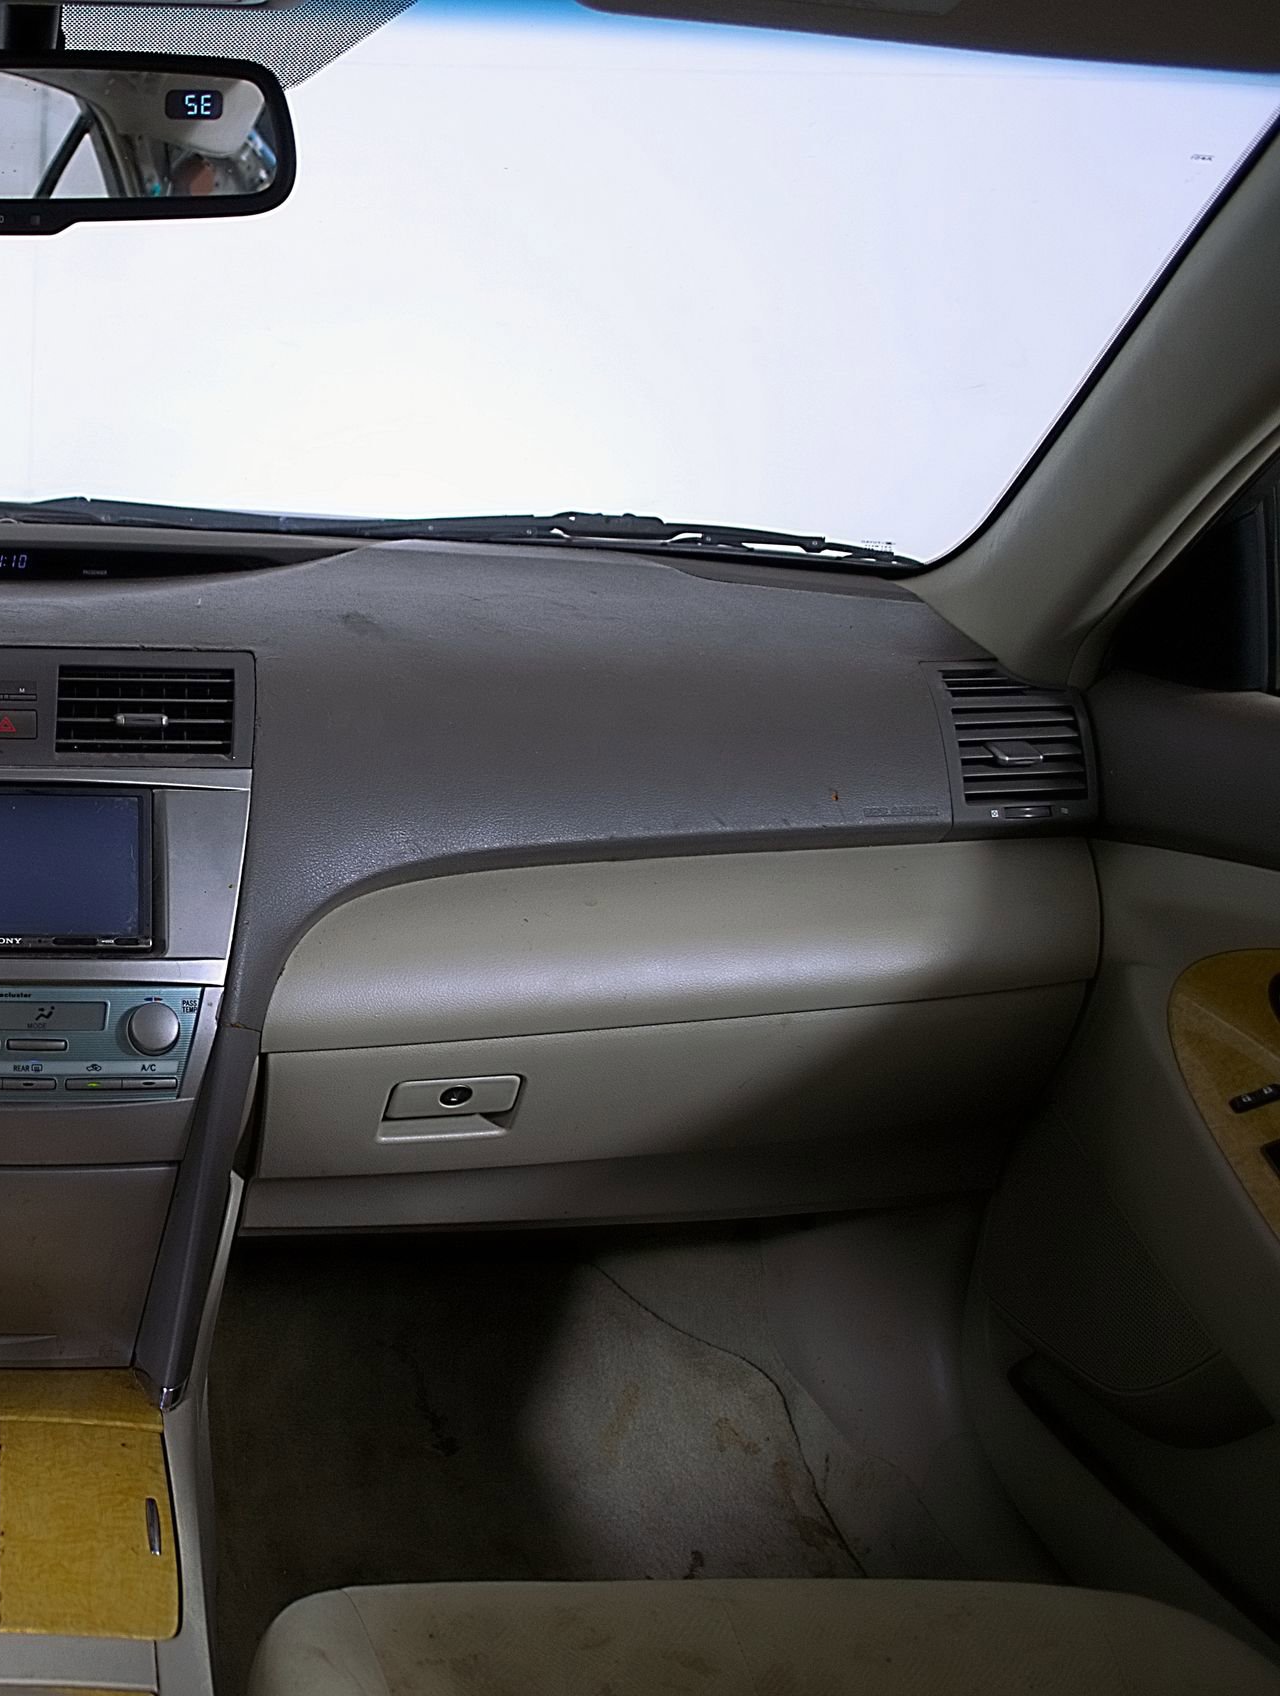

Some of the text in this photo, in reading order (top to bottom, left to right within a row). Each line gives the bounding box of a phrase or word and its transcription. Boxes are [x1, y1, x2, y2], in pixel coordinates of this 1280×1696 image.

[184, 94, 212, 115] SE
[0, 554, 28, 569] 1:10
[13, 1064, 30, 1072] REAR
[140, 1064, 157, 1072] A/C
